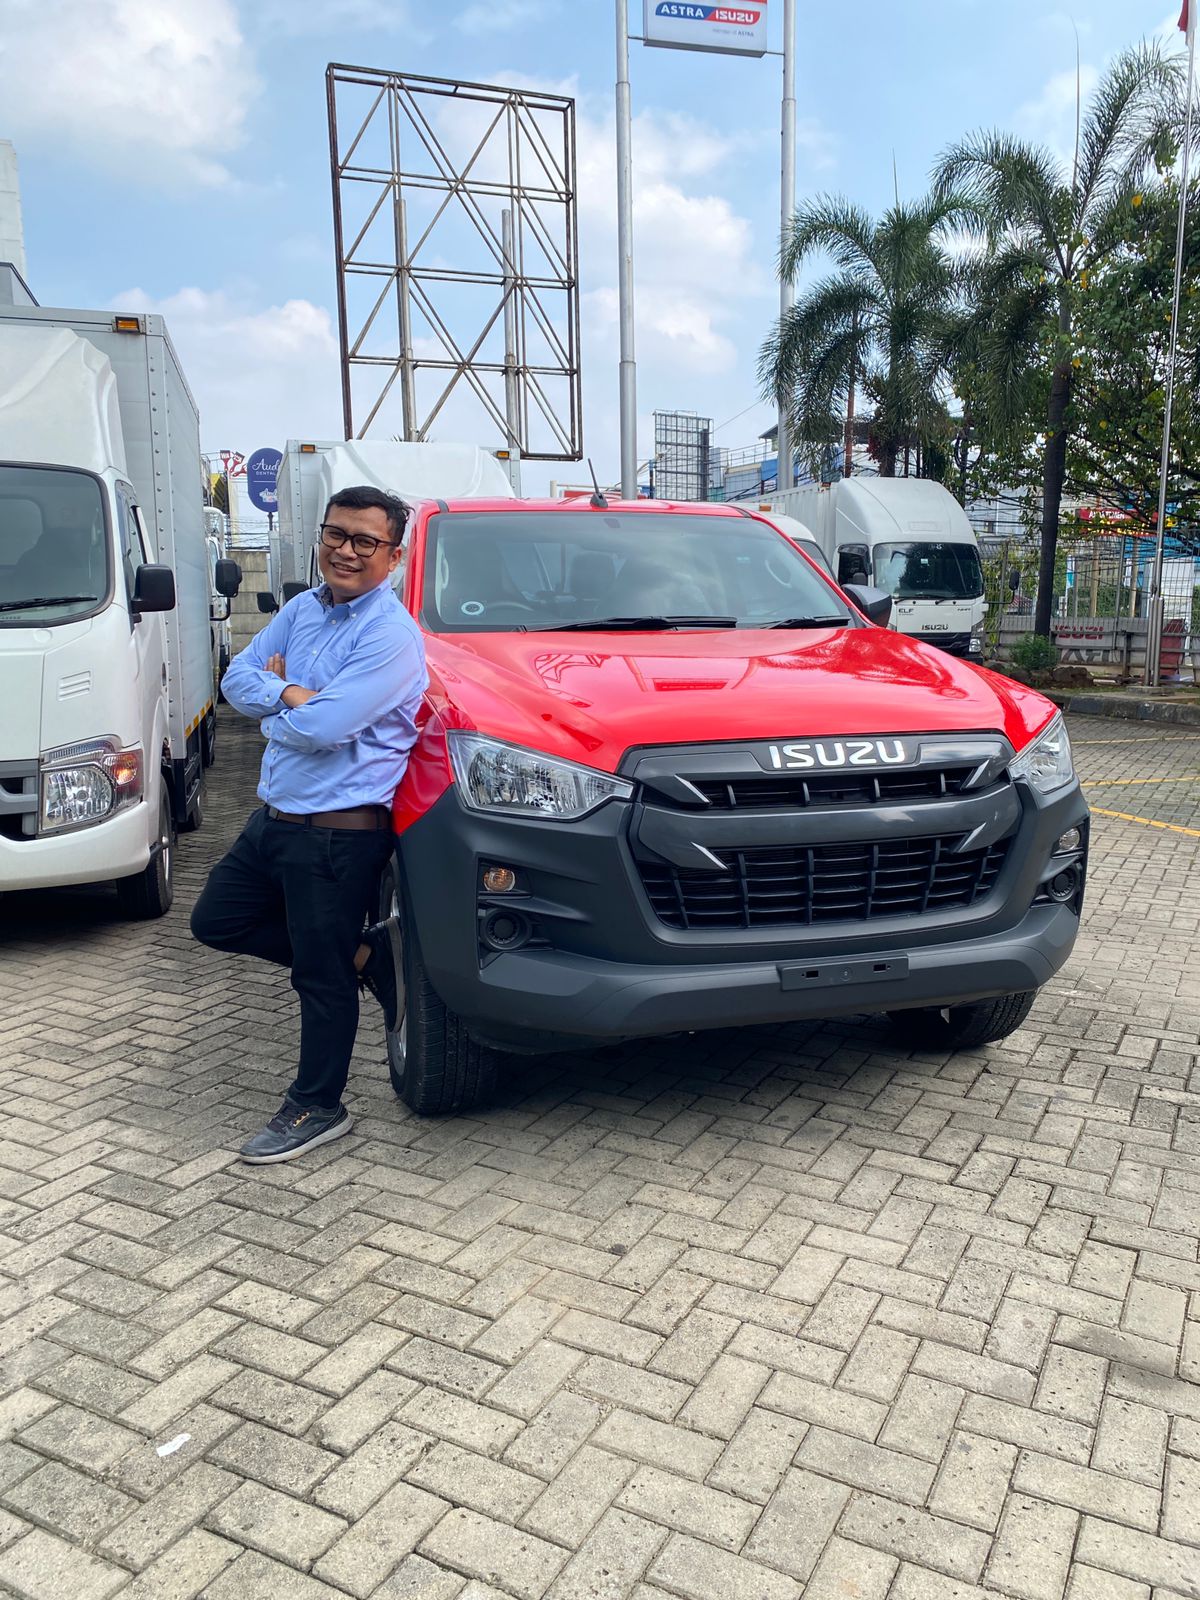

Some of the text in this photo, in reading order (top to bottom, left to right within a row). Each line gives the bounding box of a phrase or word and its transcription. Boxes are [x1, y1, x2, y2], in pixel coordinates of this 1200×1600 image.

[661, 4, 754, 23] ASTRA ISUZU
[252, 458, 280, 471] Aud
[769, 740, 906, 769] ISUZU
